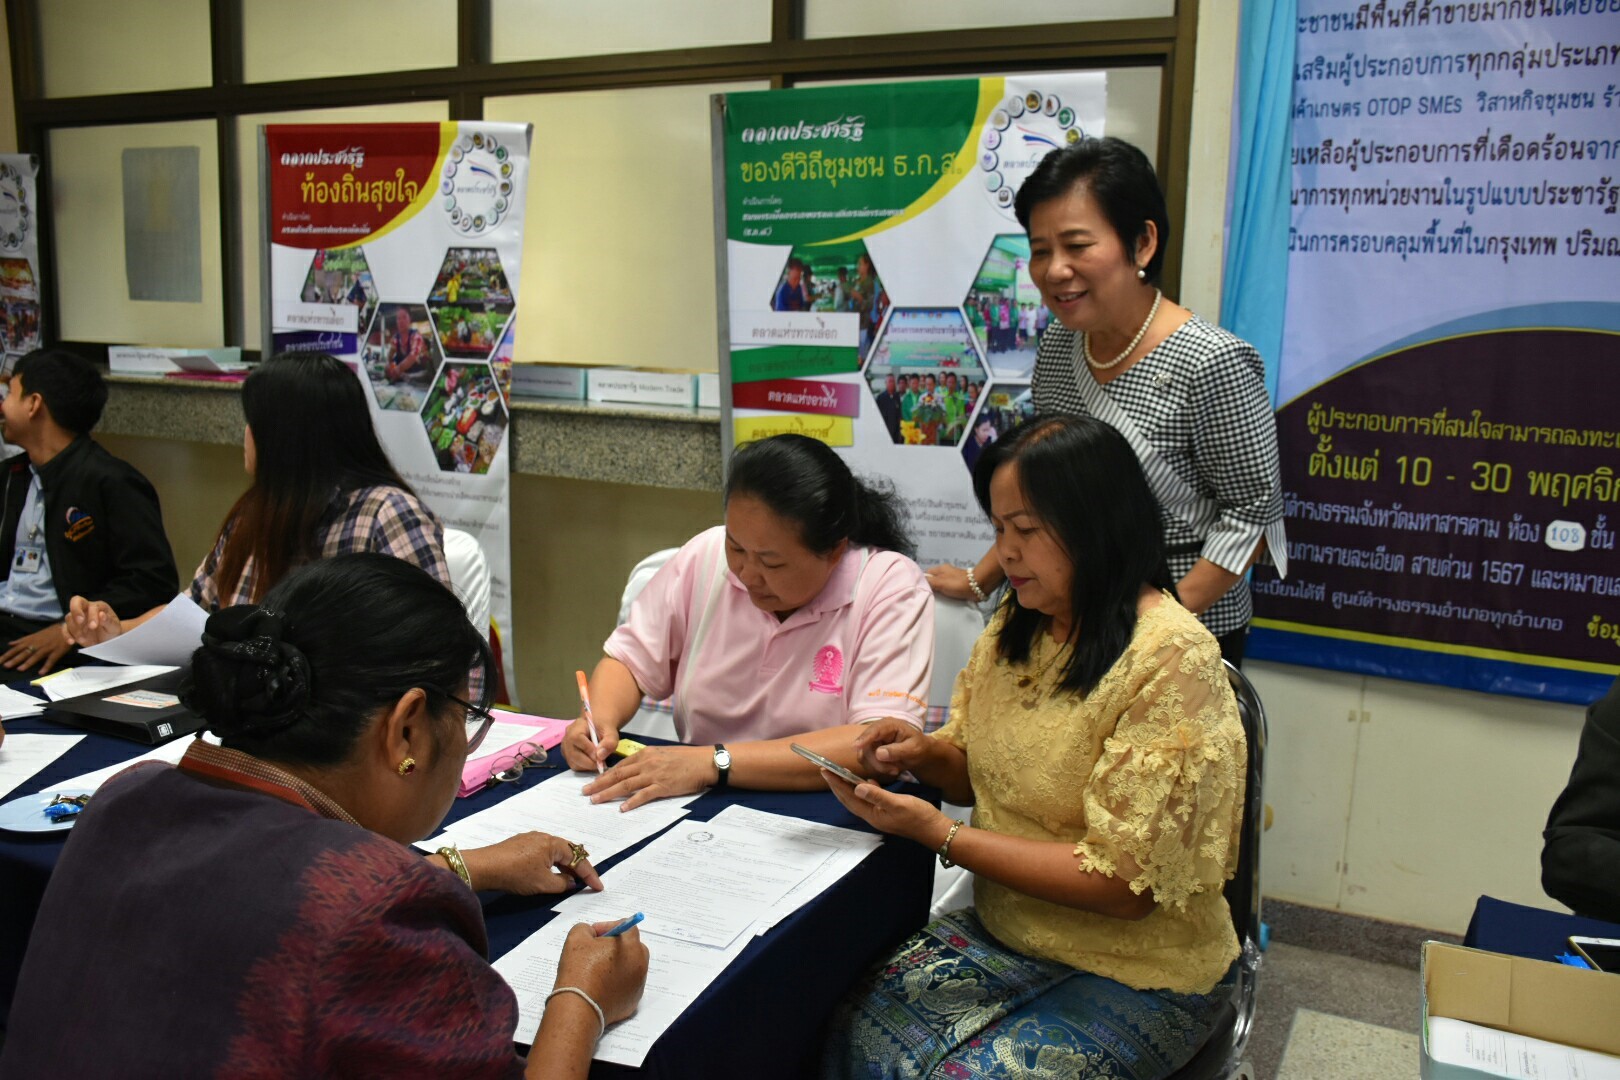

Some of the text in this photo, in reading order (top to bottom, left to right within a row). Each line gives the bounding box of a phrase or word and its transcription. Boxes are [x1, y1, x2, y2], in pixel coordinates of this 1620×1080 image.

[1367, 97, 1411, 116] OTOP
[1418, 94, 1462, 115] SMEs
[1477, 88, 1595, 117] วิสาหกิจชุมชน
[741, 113, 865, 145] ตลาดประชารัฐ
[280, 144, 365, 169] ตลาดประชารัฐ
[740, 149, 885, 188] ของดีวิถีชุมชน
[301, 164, 418, 212] ท้องถิ่นสุขใจ
[1308, 433, 1379, 482] ตั้งแต่
[1396, 455, 1432, 487] 10
[1470, 461, 1511, 494] 30
[1508, 513, 1540, 543] ห้อง
[1551, 526, 1581, 544] 108
[1590, 514, 1614, 550] ชั้น
[1411, 553, 1473, 580] สายด่วน
[1481, 560, 1524, 586] 1567
[1253, 579, 1326, 602] ะเบียนได้ที่
